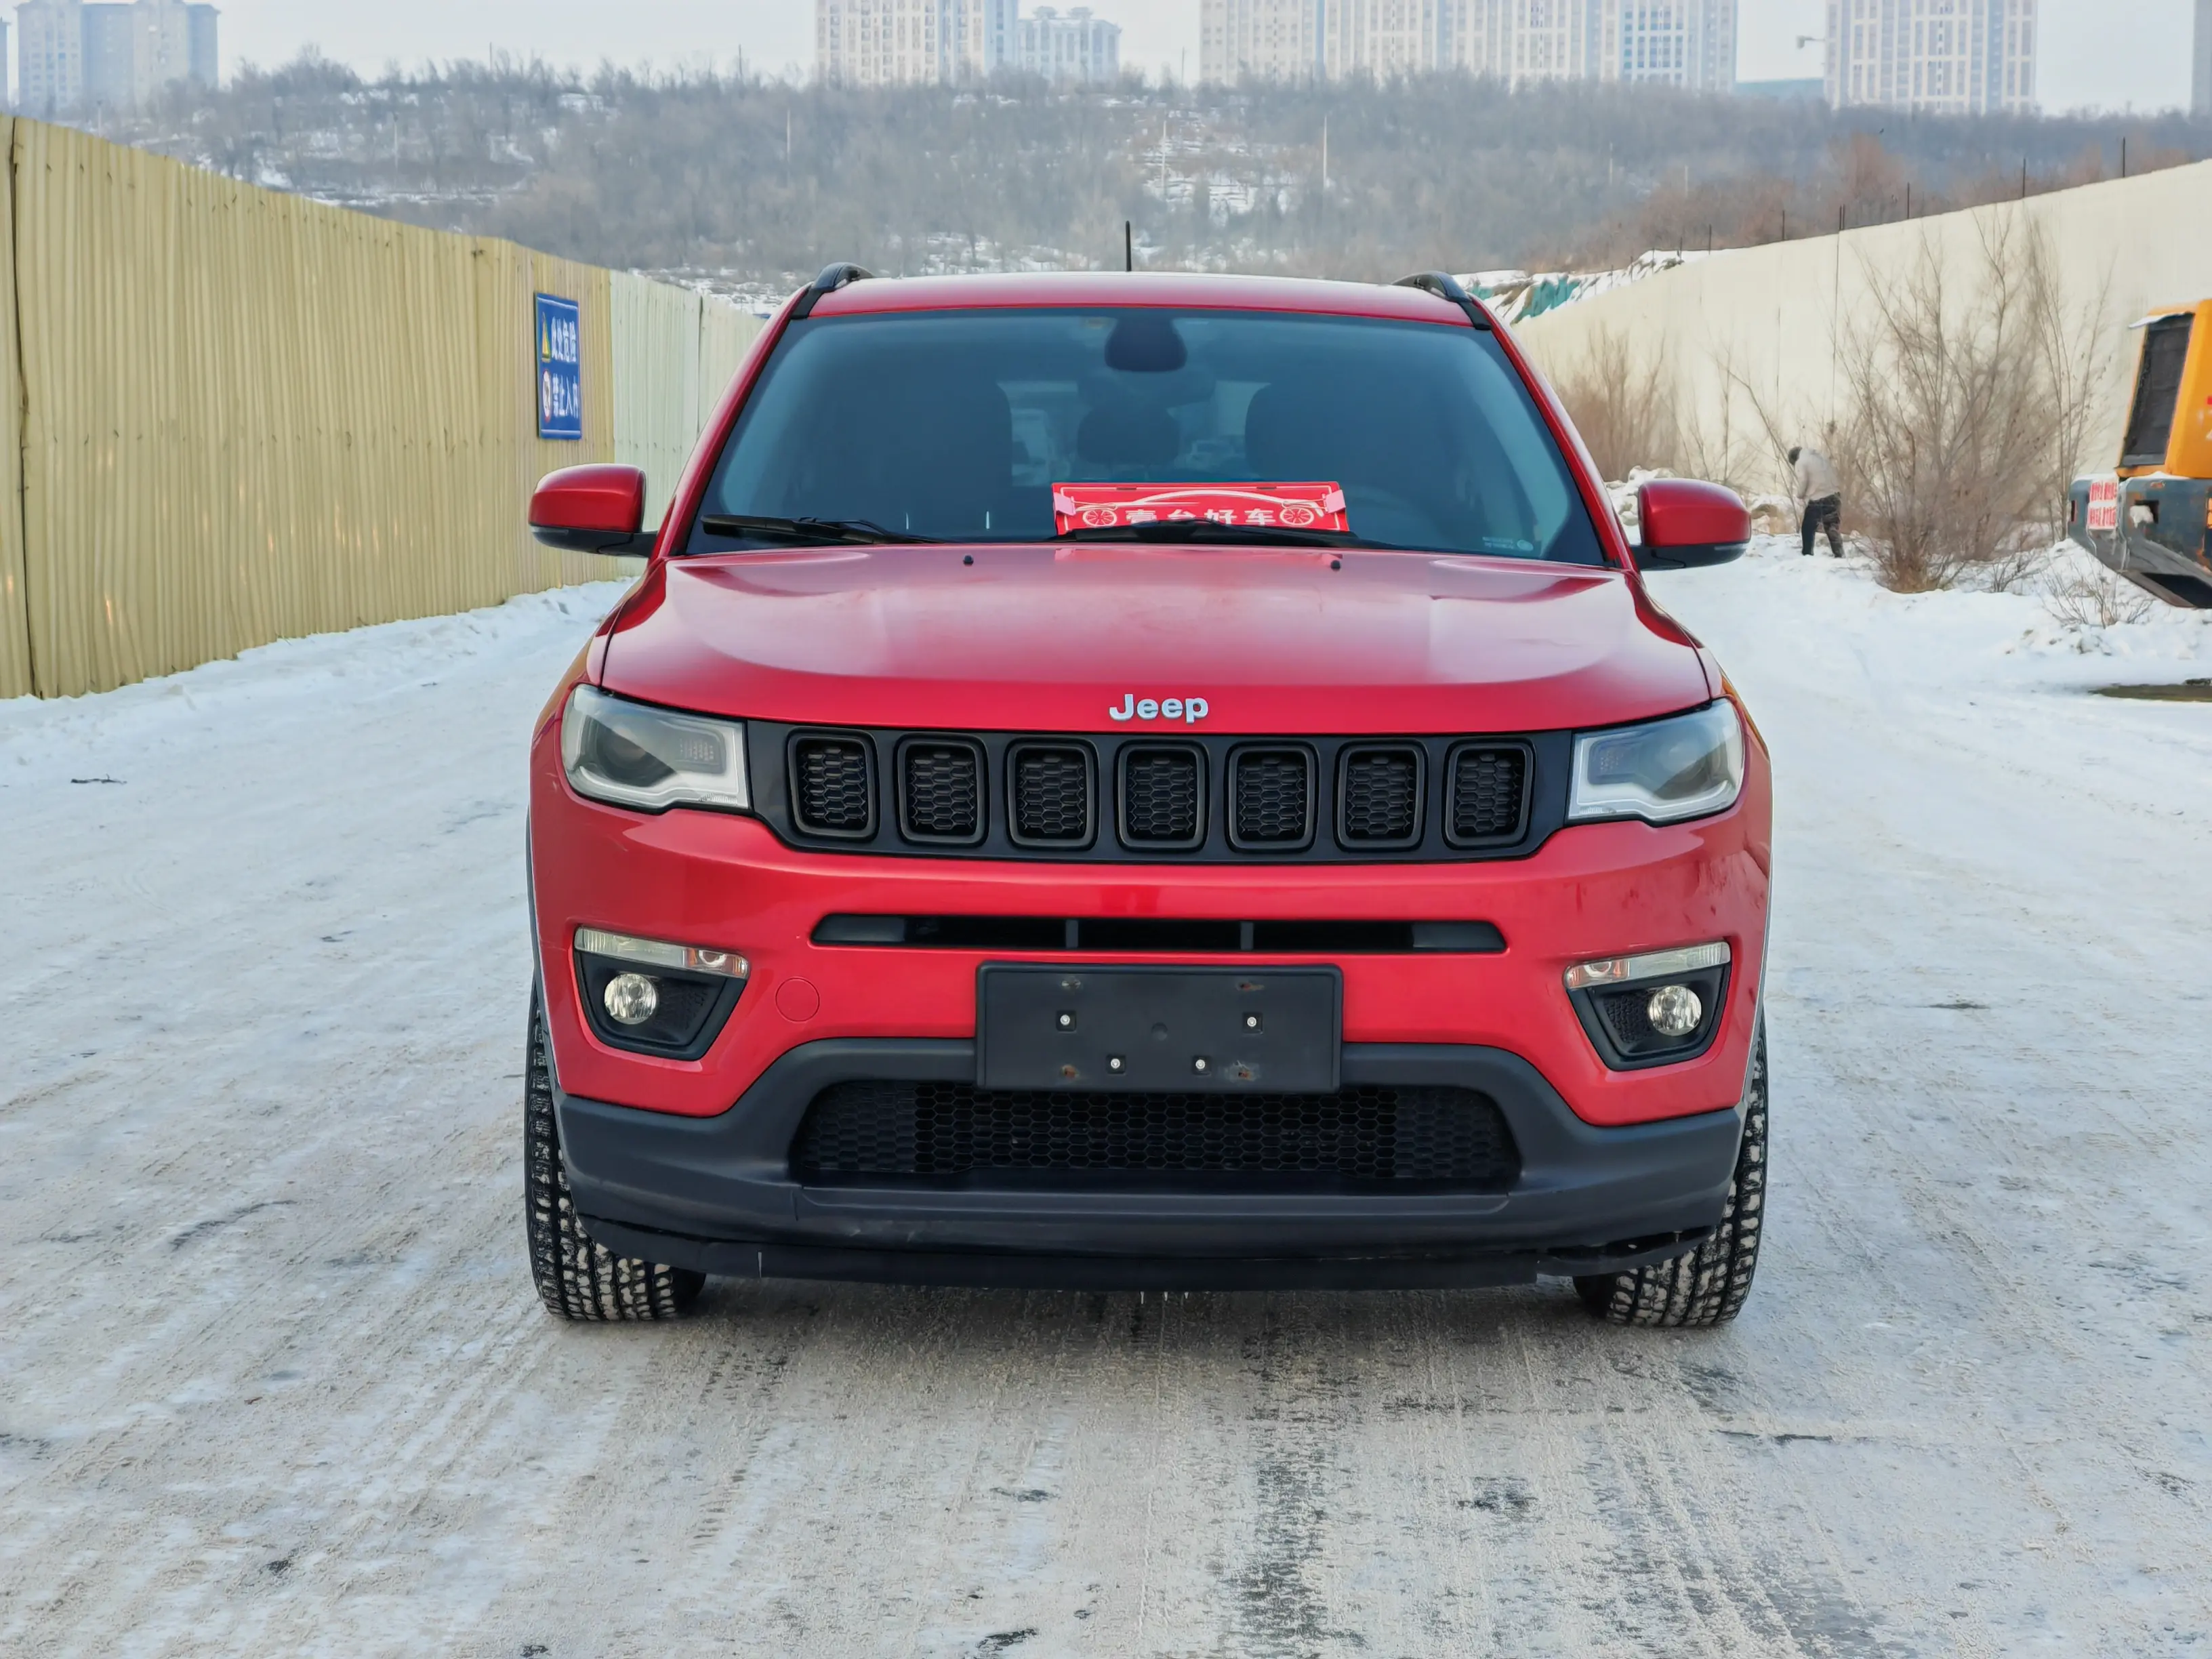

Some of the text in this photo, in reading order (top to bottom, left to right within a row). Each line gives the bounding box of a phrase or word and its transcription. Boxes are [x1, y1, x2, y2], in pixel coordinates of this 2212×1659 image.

[552, 373, 579, 419] 禁止入内
[1109, 693, 1208, 724] Jeep
